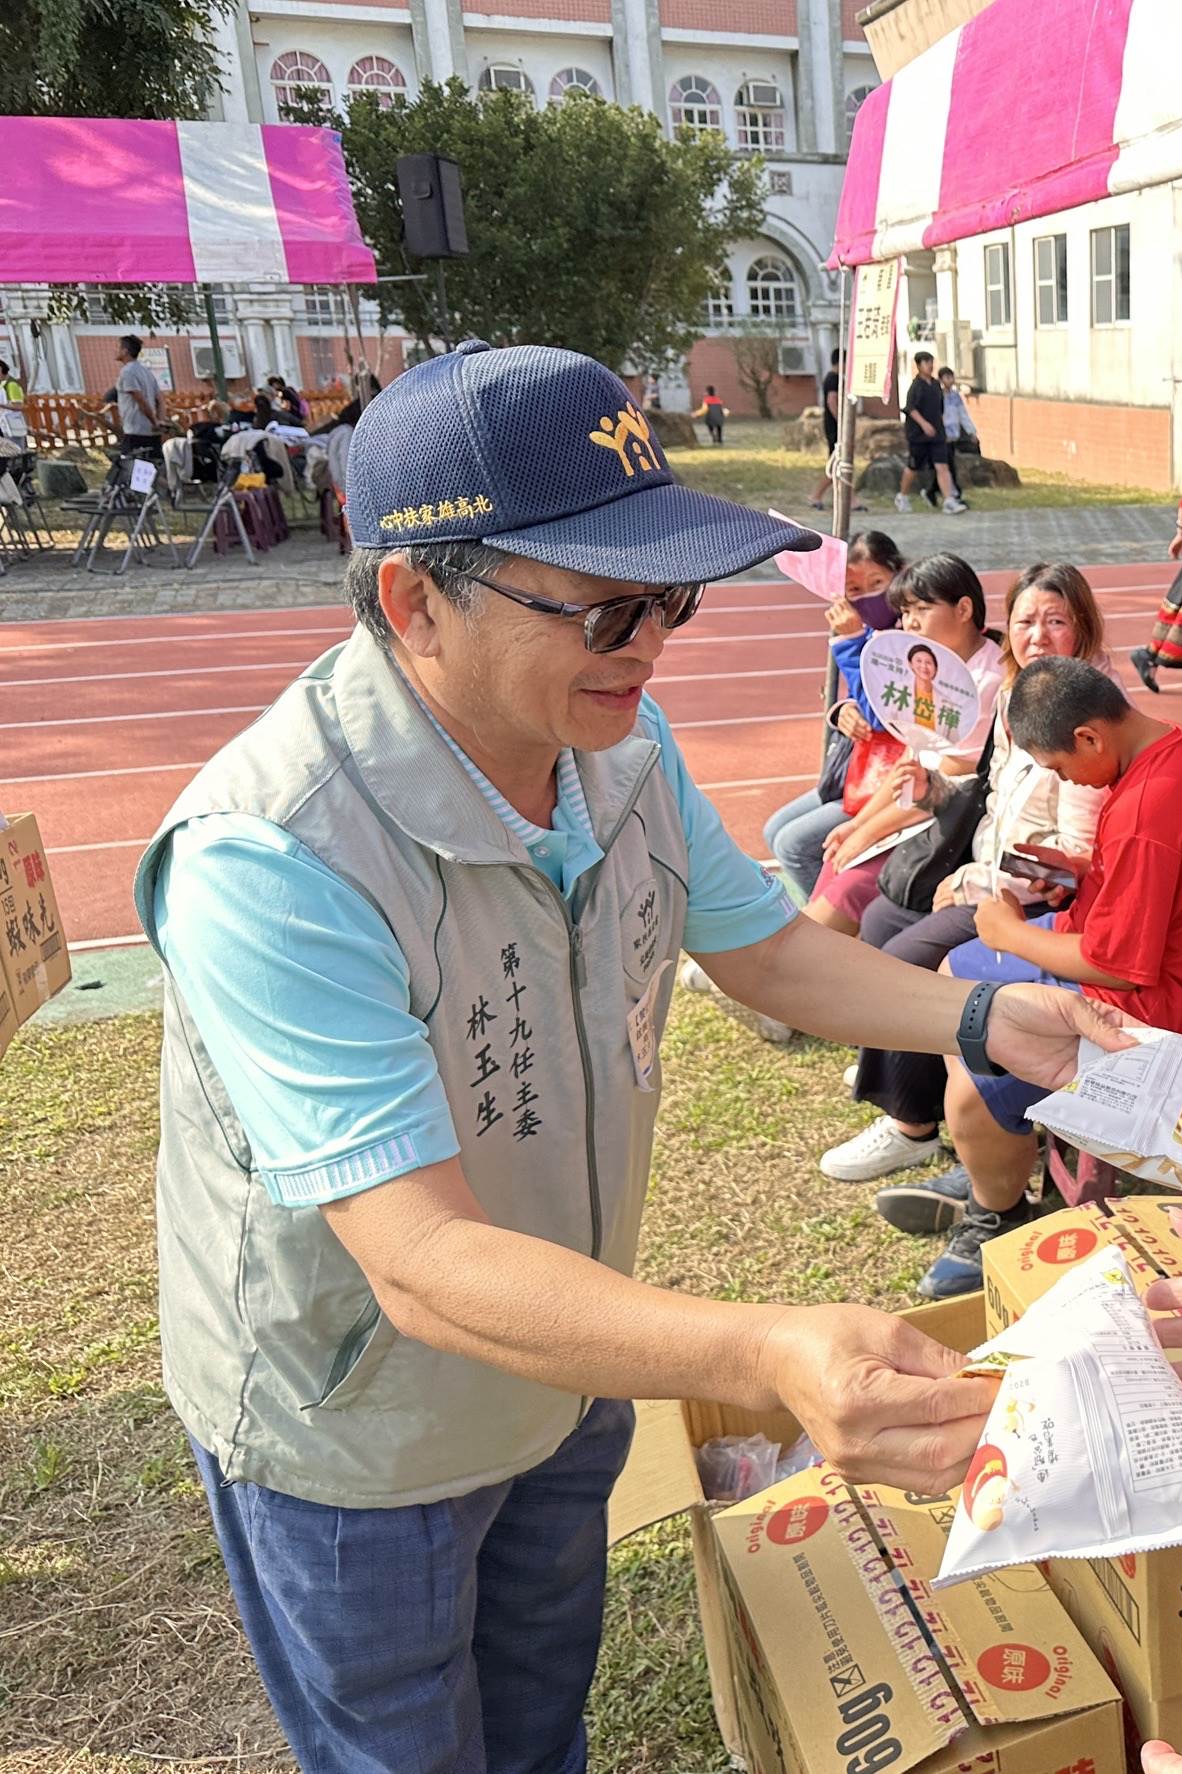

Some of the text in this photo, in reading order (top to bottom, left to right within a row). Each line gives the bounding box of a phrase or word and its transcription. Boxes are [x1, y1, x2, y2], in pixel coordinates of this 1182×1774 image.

[466, 995, 504, 1137] 林玉生
[501, 942, 543, 1142] 第十九任主委
[1020, 1230, 1042, 1272] Original
[747, 1498, 777, 1553] Original
[1001, 1647, 1029, 1684] 原味
[1044, 1645, 1073, 1700] Original
[836, 1682, 903, 1774] 60g
